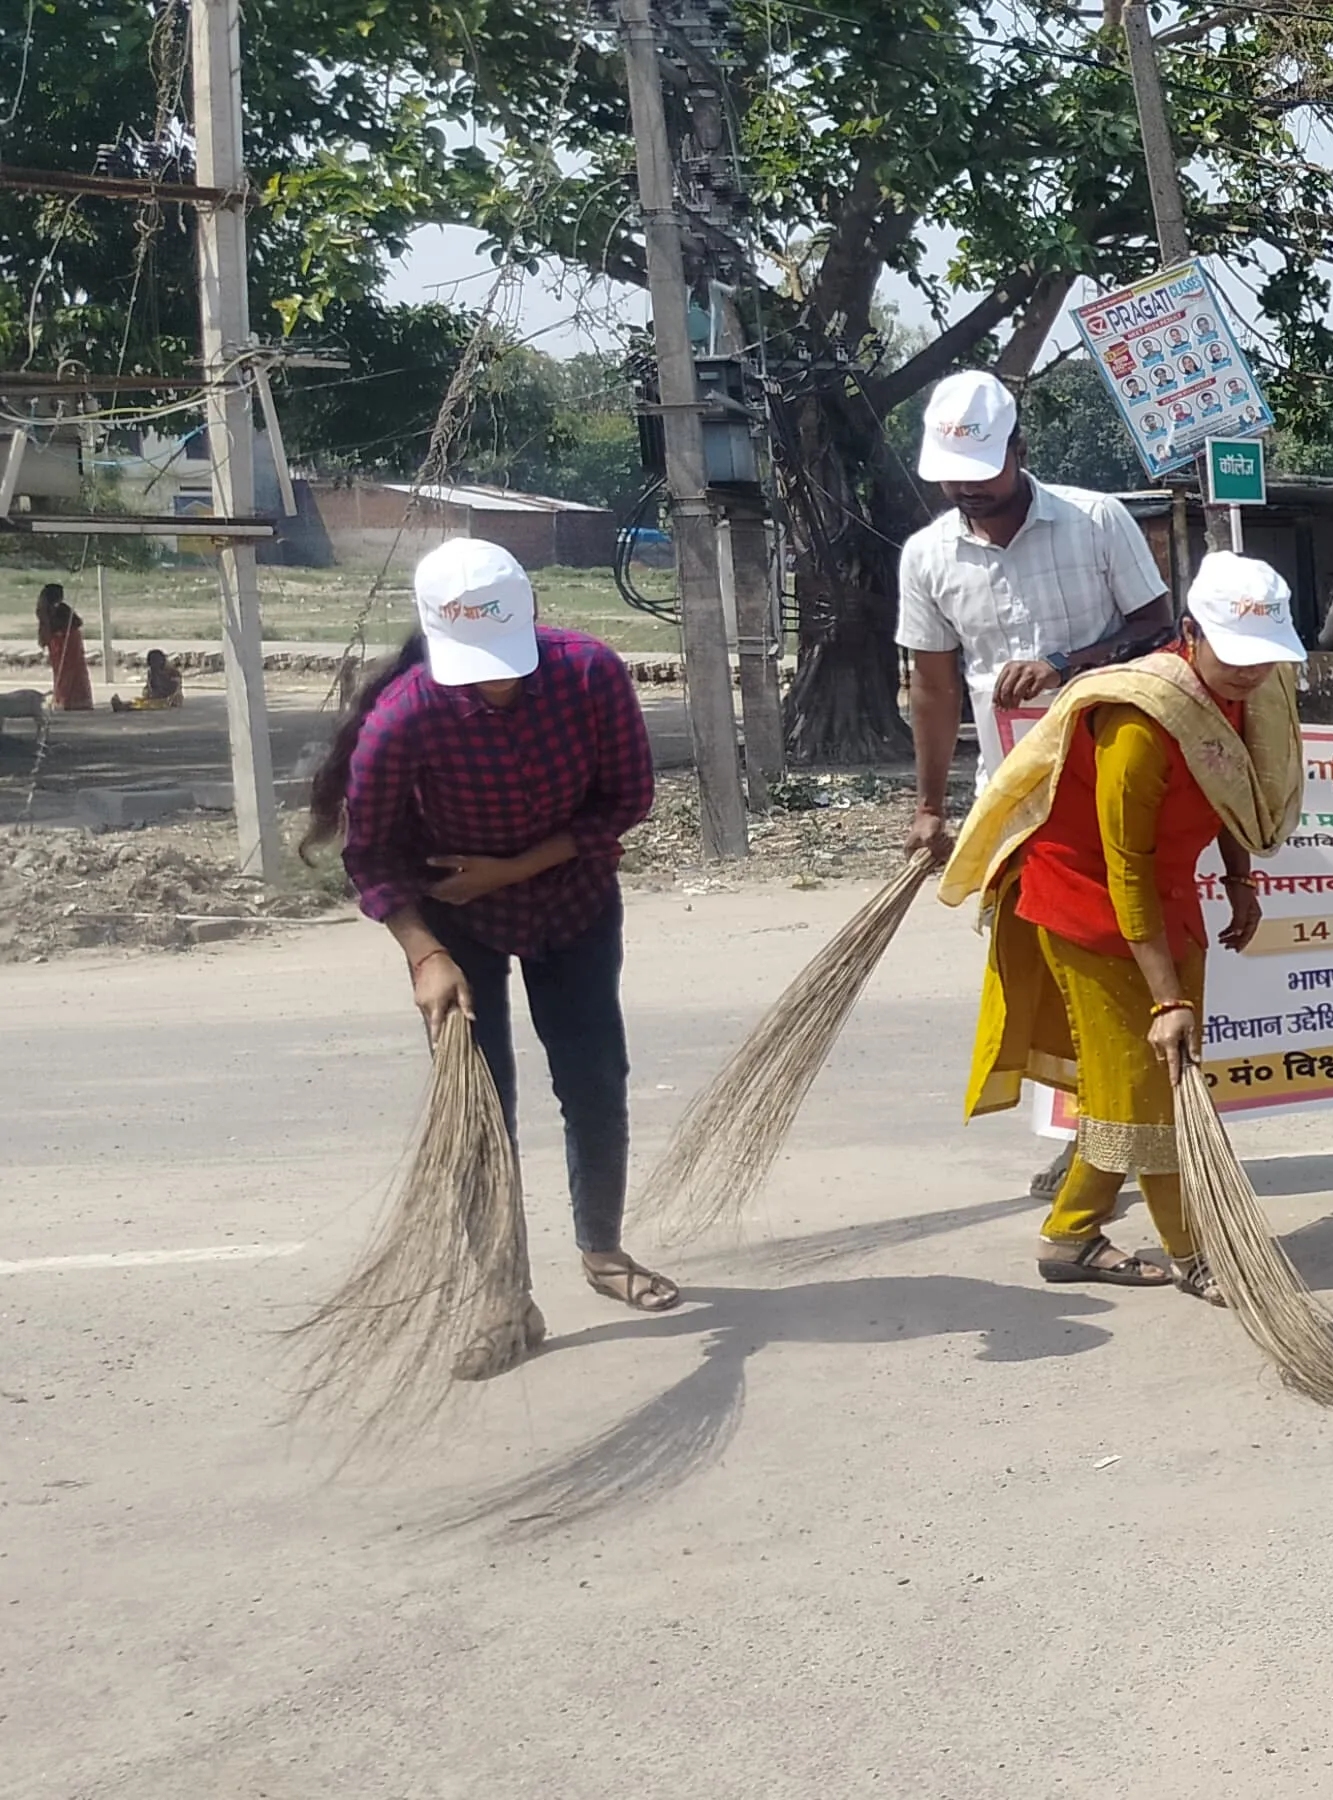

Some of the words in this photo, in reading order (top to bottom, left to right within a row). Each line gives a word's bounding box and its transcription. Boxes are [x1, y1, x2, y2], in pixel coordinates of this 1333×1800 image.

[1105, 288, 1175, 333] PRAGATI
[1169, 275, 1203, 298] CLASSES
[1218, 453, 1254, 475] कॉलेज
[1292, 921, 1330, 943] 14
